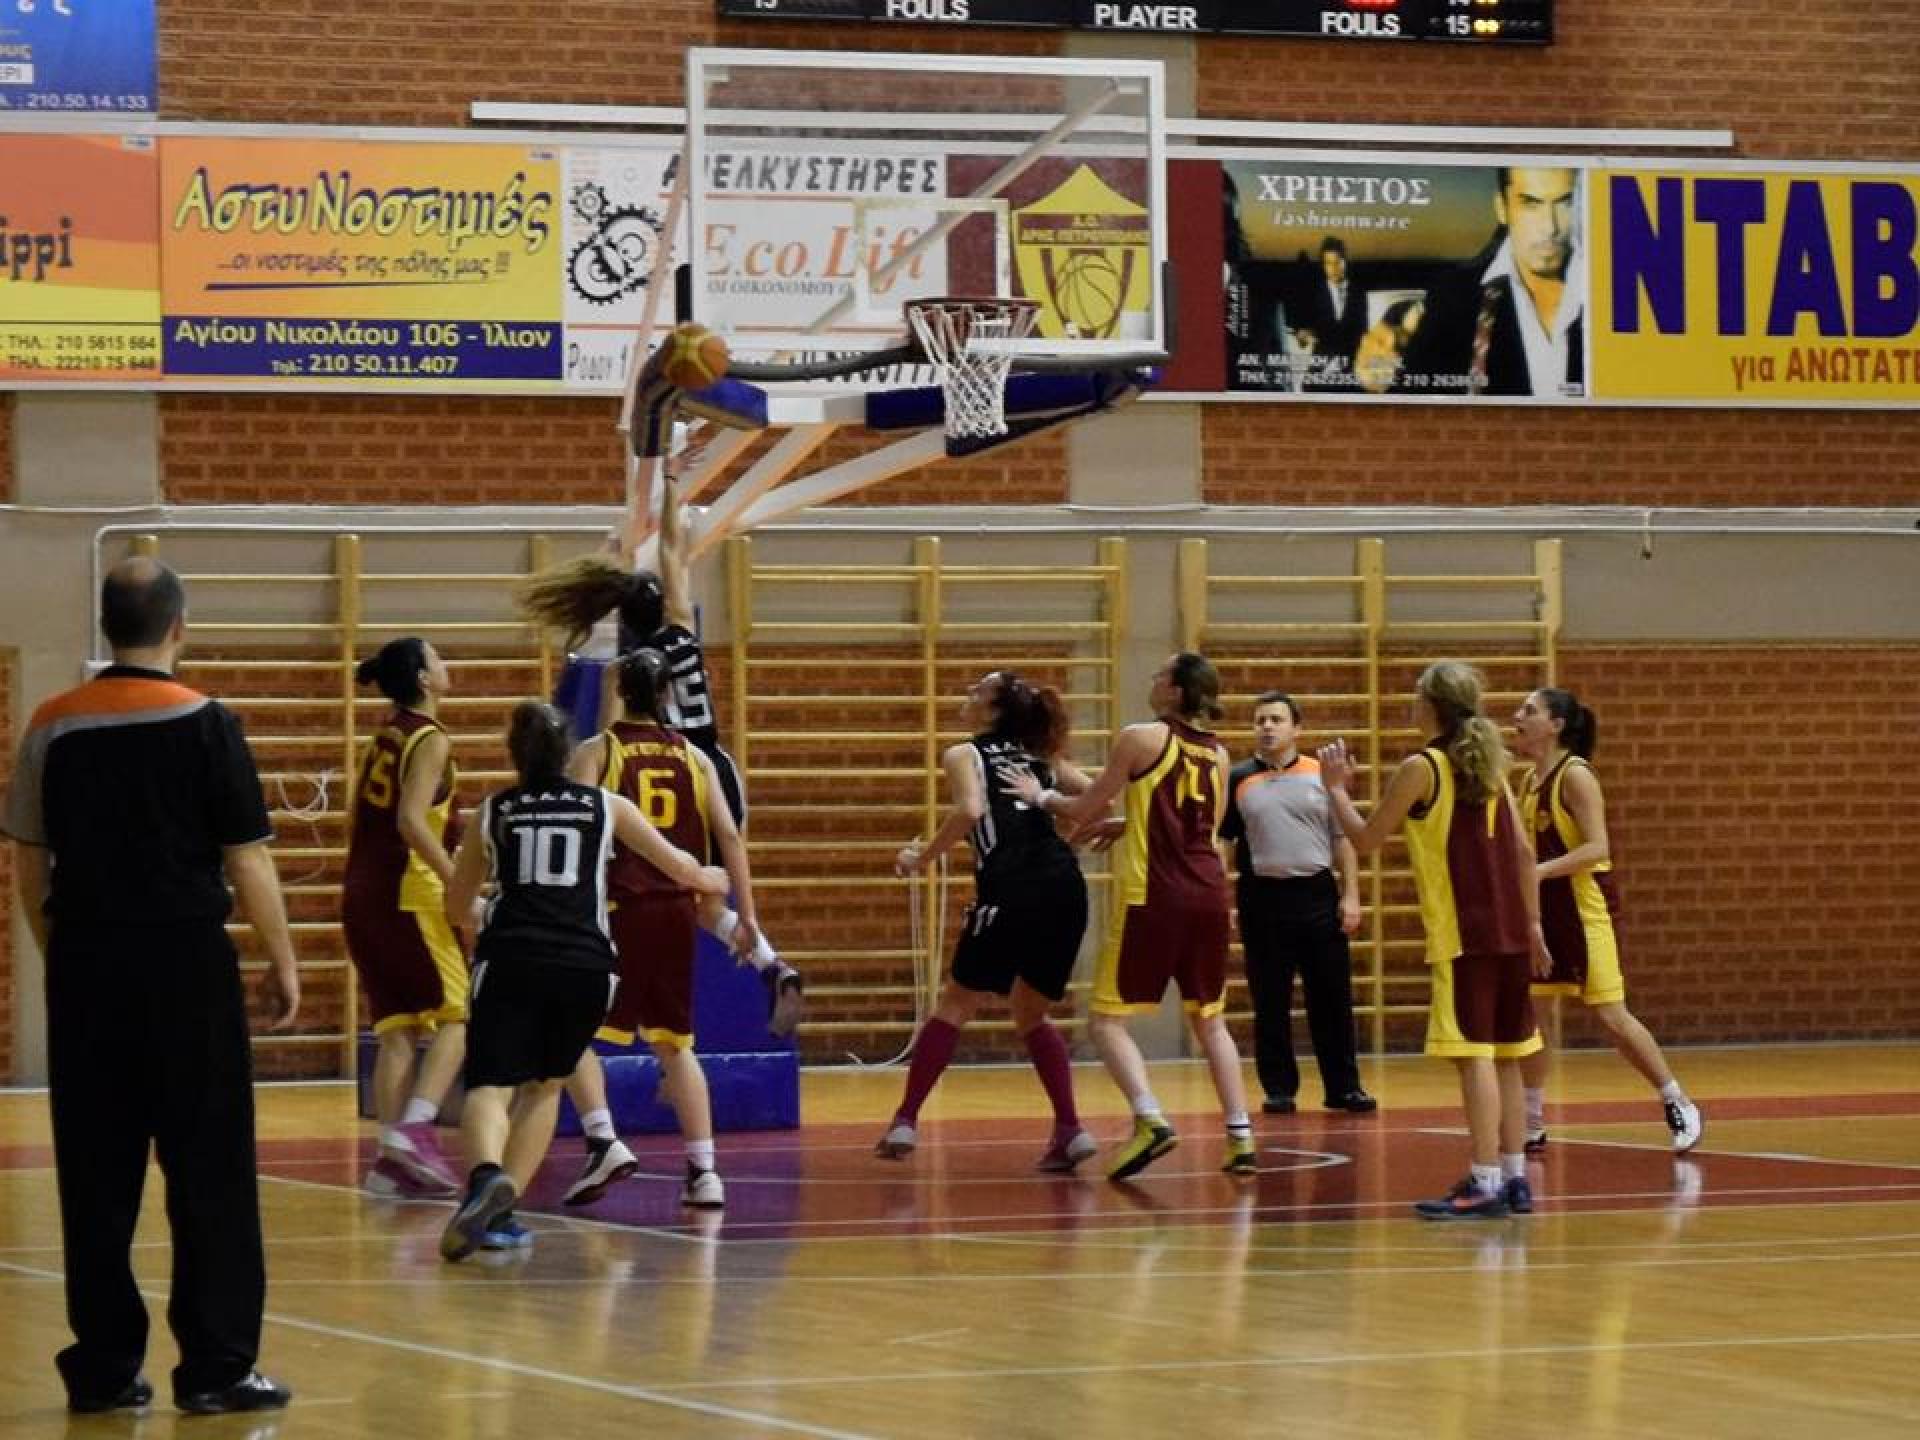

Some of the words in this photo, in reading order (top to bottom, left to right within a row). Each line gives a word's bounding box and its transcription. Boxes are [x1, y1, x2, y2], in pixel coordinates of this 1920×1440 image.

[885, 0, 969, 20] FOULS
[1093, 4, 1198, 30] PLAYER
[1320, 11, 1401, 36] FOULS
[1447, 15, 1471, 35] 15
[660, 152, 938, 194] ΑΕΛΚΥΣΤΗΡΕΣ
[1256, 175, 1431, 205] ΧΡΗΣΤΟΣ
[56, 335, 83, 350] 210
[174, 319, 256, 348] Αγίου
[265, 320, 399, 346] Νικολάου
[409, 323, 461, 346] 106
[308, 353, 349, 372] 210
[354, 354, 459, 375] 50.11.407
[1730, 355, 1776, 391] για
[638, 768, 677, 828] 6
[511, 825, 581, 887] 10
